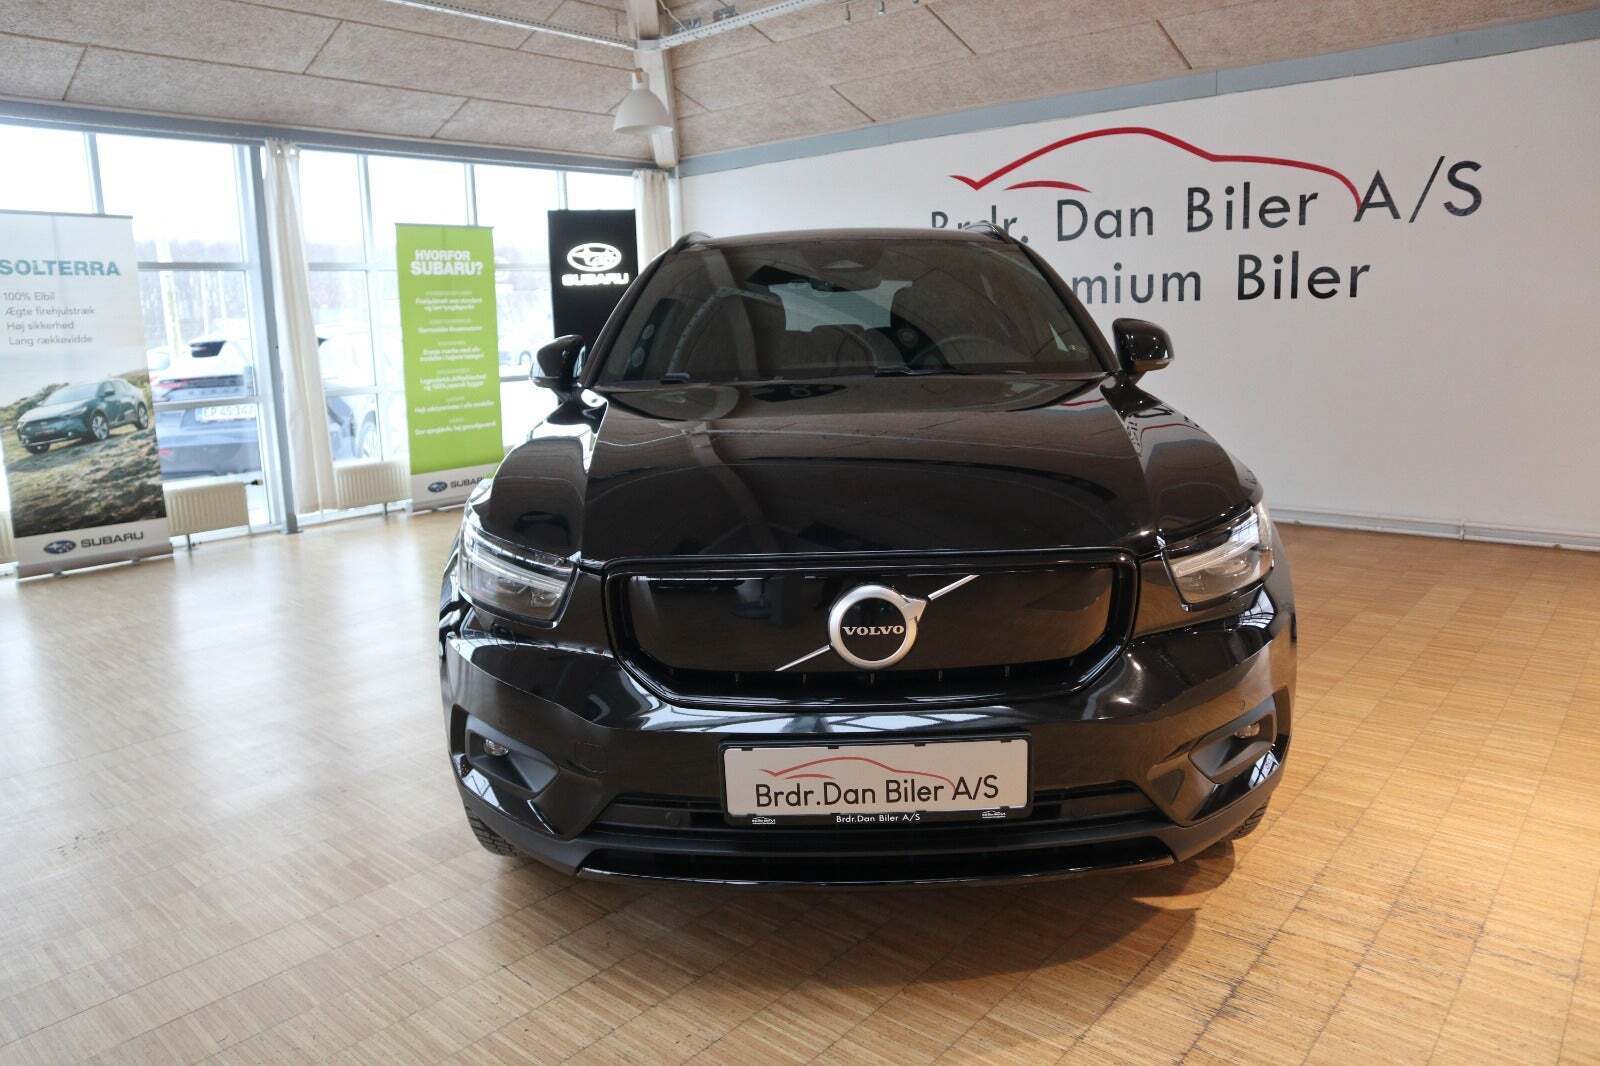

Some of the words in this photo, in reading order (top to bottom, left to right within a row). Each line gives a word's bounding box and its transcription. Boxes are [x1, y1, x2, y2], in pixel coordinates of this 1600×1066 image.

[1057, 198, 1154, 242] Dan
[1187, 181, 1319, 232] Biler
[1353, 155, 1482, 223] A/S
[0, 259, 121, 276] SOLTERRA
[411, 261, 483, 275] SUBARU?
[1072, 262, 1202, 305] mium
[1237, 250, 1371, 300] Biler
[3, 291, 31, 301] 100%
[81, 531, 143, 548] SUBARU
[842, 625, 905, 636] VOLVO
[886, 779, 944, 803] Biler
[952, 774, 999, 801] A/S
[880, 813, 898, 822] Biler
[902, 812, 921, 822] A/S
